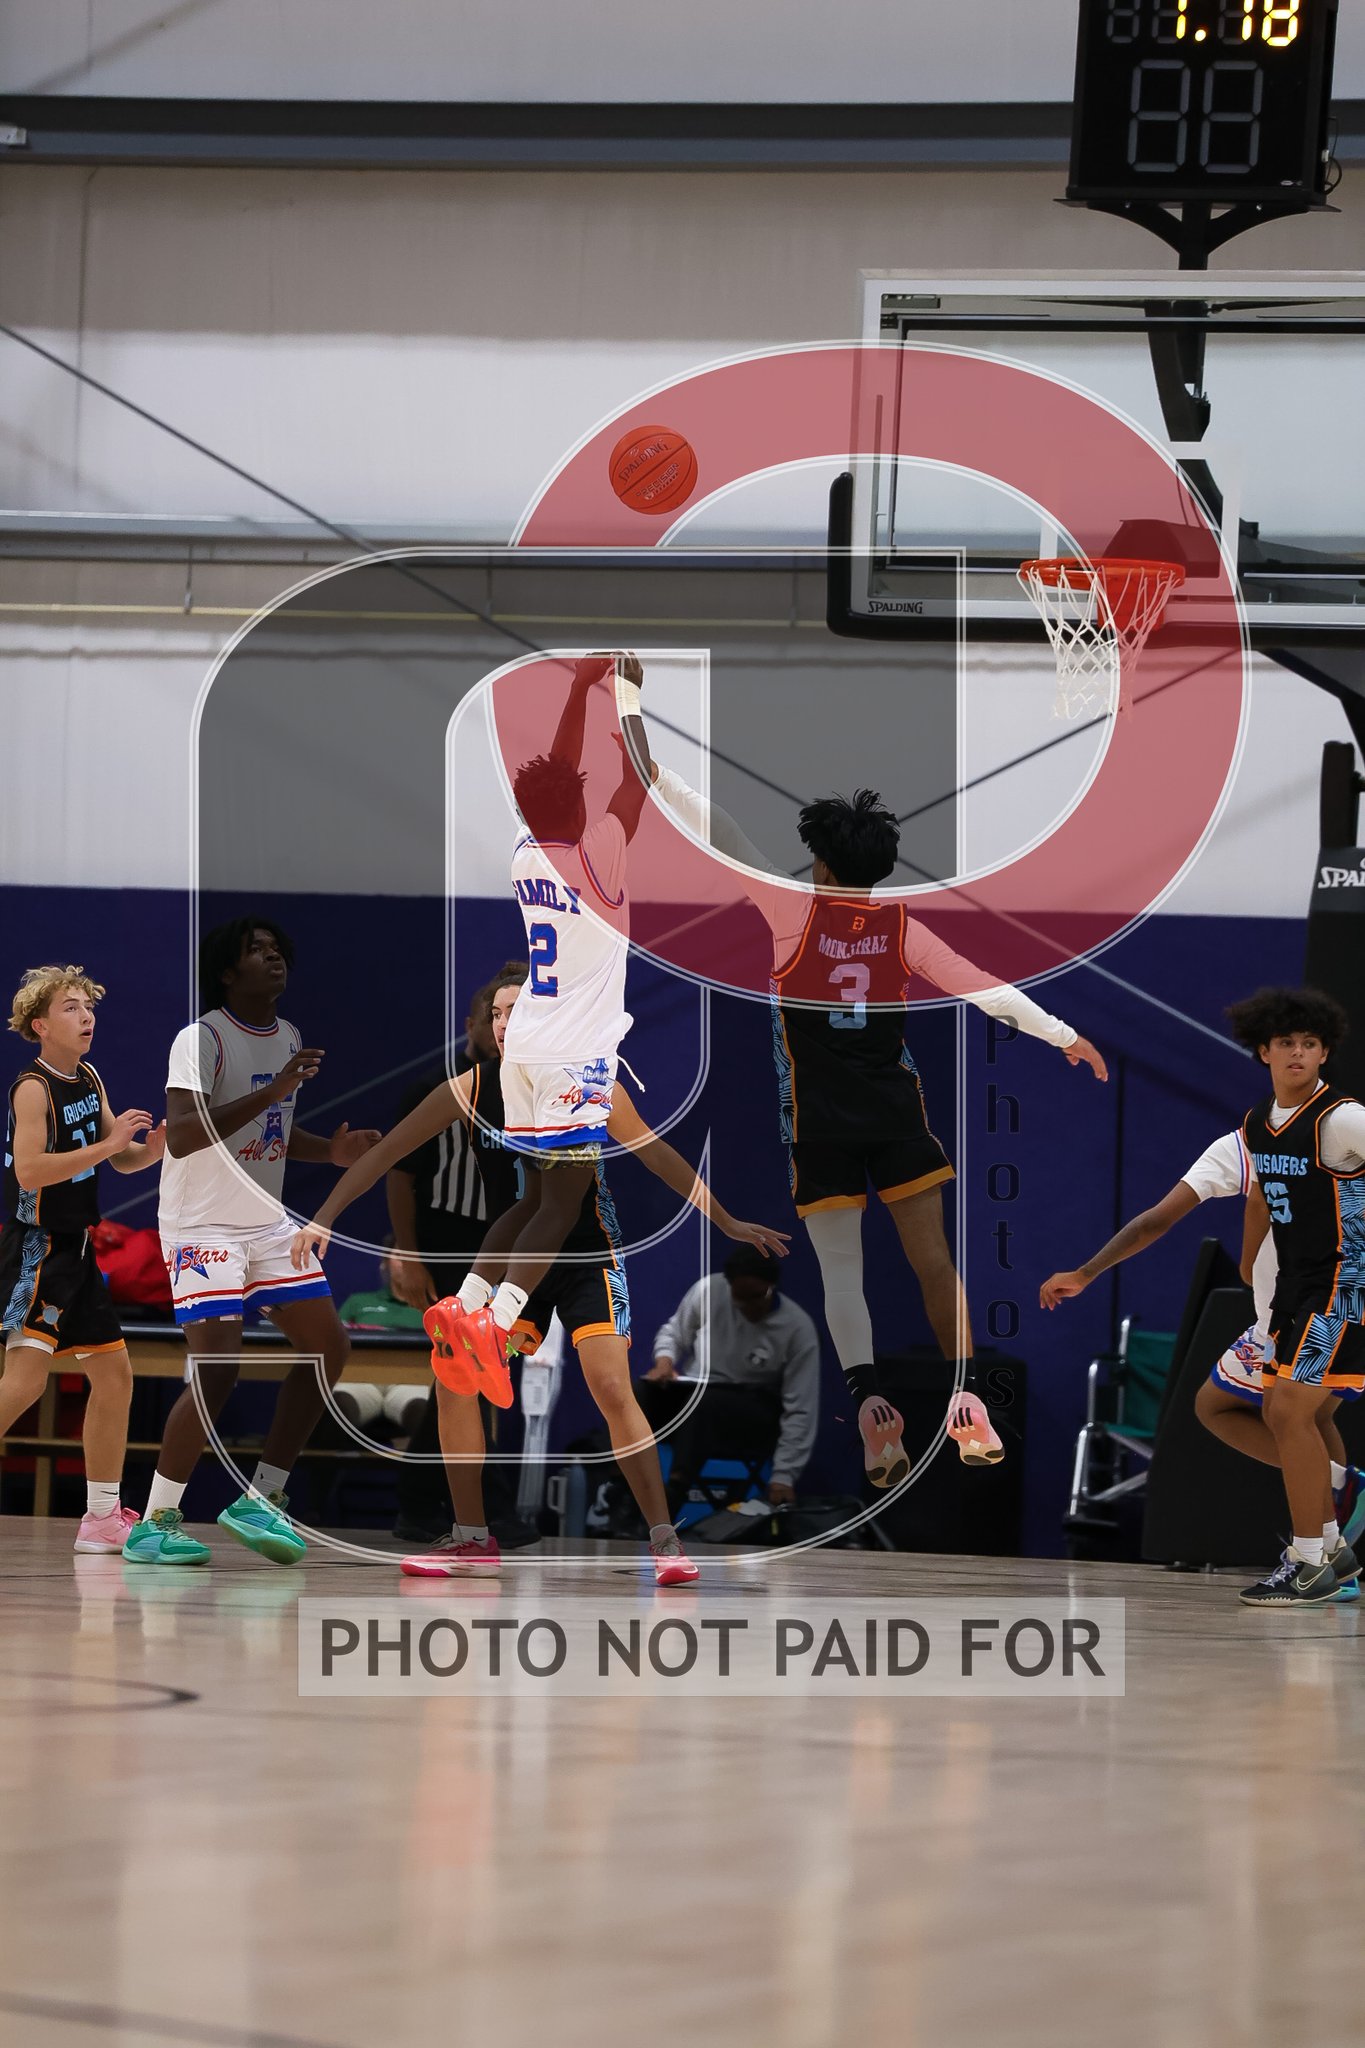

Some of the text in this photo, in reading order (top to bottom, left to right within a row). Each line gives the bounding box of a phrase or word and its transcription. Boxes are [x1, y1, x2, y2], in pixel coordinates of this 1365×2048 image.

[868, 600, 923, 614] SPALDING
[529, 922, 558, 997] 2
[828, 963, 870, 1029] 3
[181, 1245, 229, 1271] Stars
